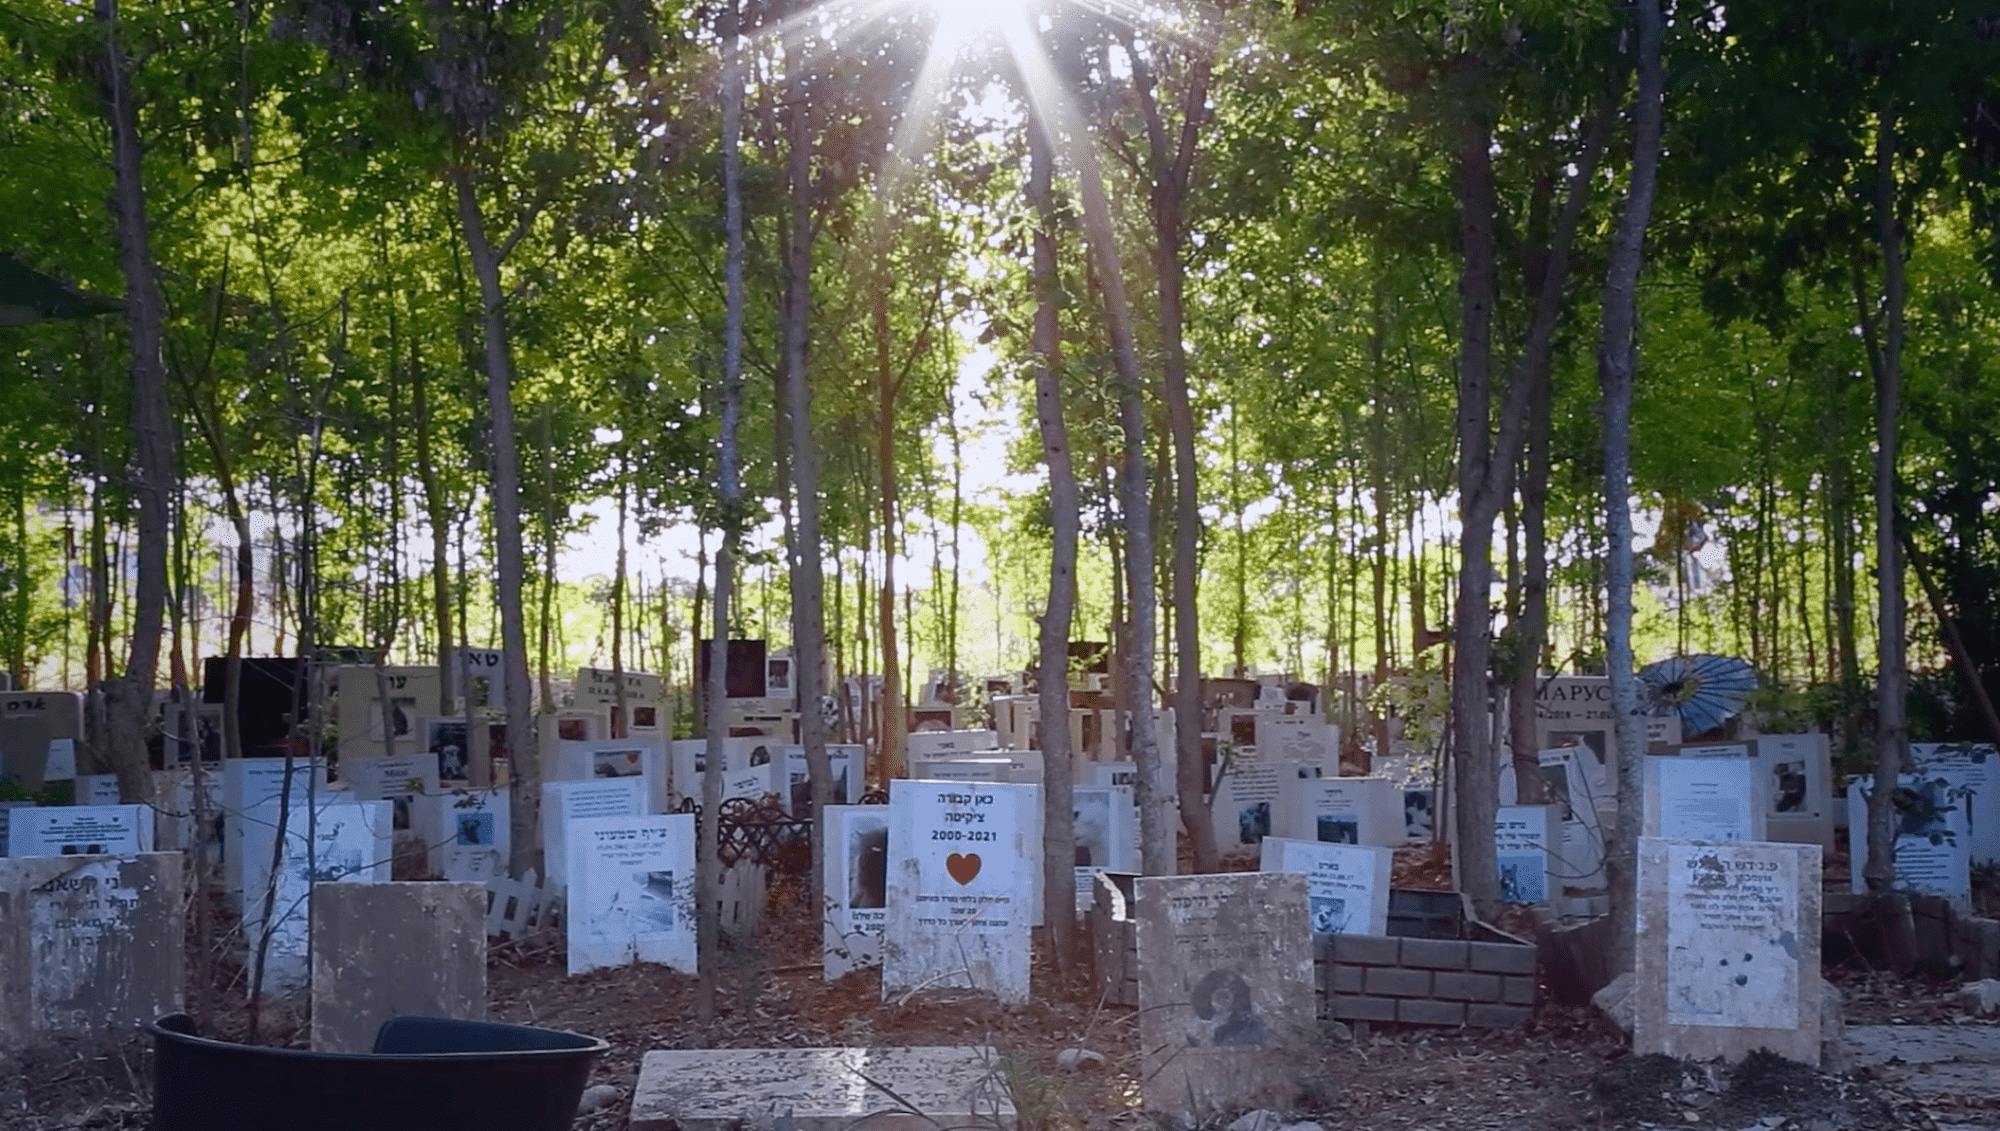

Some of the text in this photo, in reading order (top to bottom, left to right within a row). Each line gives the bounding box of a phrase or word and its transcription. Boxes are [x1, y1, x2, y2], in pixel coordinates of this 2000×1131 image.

[937, 793, 994, 806] כאן קבורה
[931, 830, 997, 842] 2000-2021
